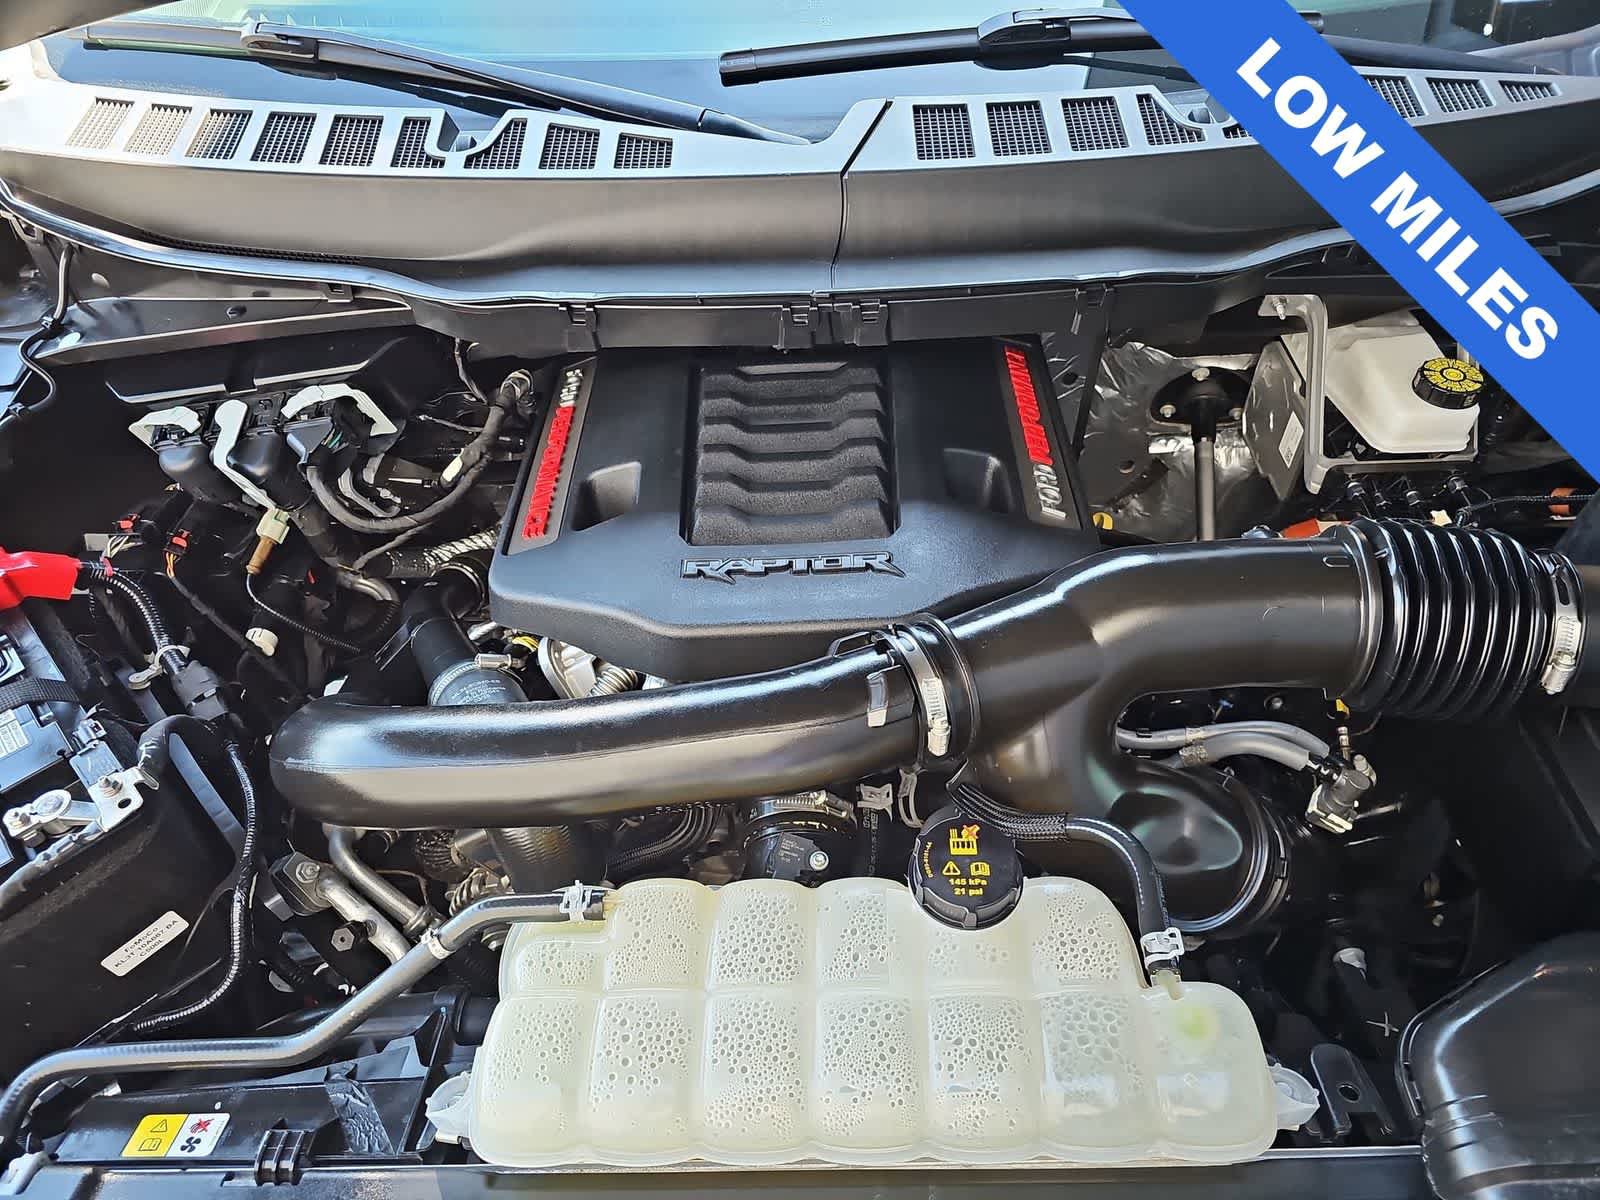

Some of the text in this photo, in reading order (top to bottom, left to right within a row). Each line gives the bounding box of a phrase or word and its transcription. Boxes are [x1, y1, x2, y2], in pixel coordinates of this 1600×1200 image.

[1033, 463, 1067, 520] FORD
[680, 551, 907, 585] RAPTOR
[948, 878, 988, 886] 145 kPa
[954, 887, 966, 896] 21
[124, 926, 159, 953] FoMoCo
